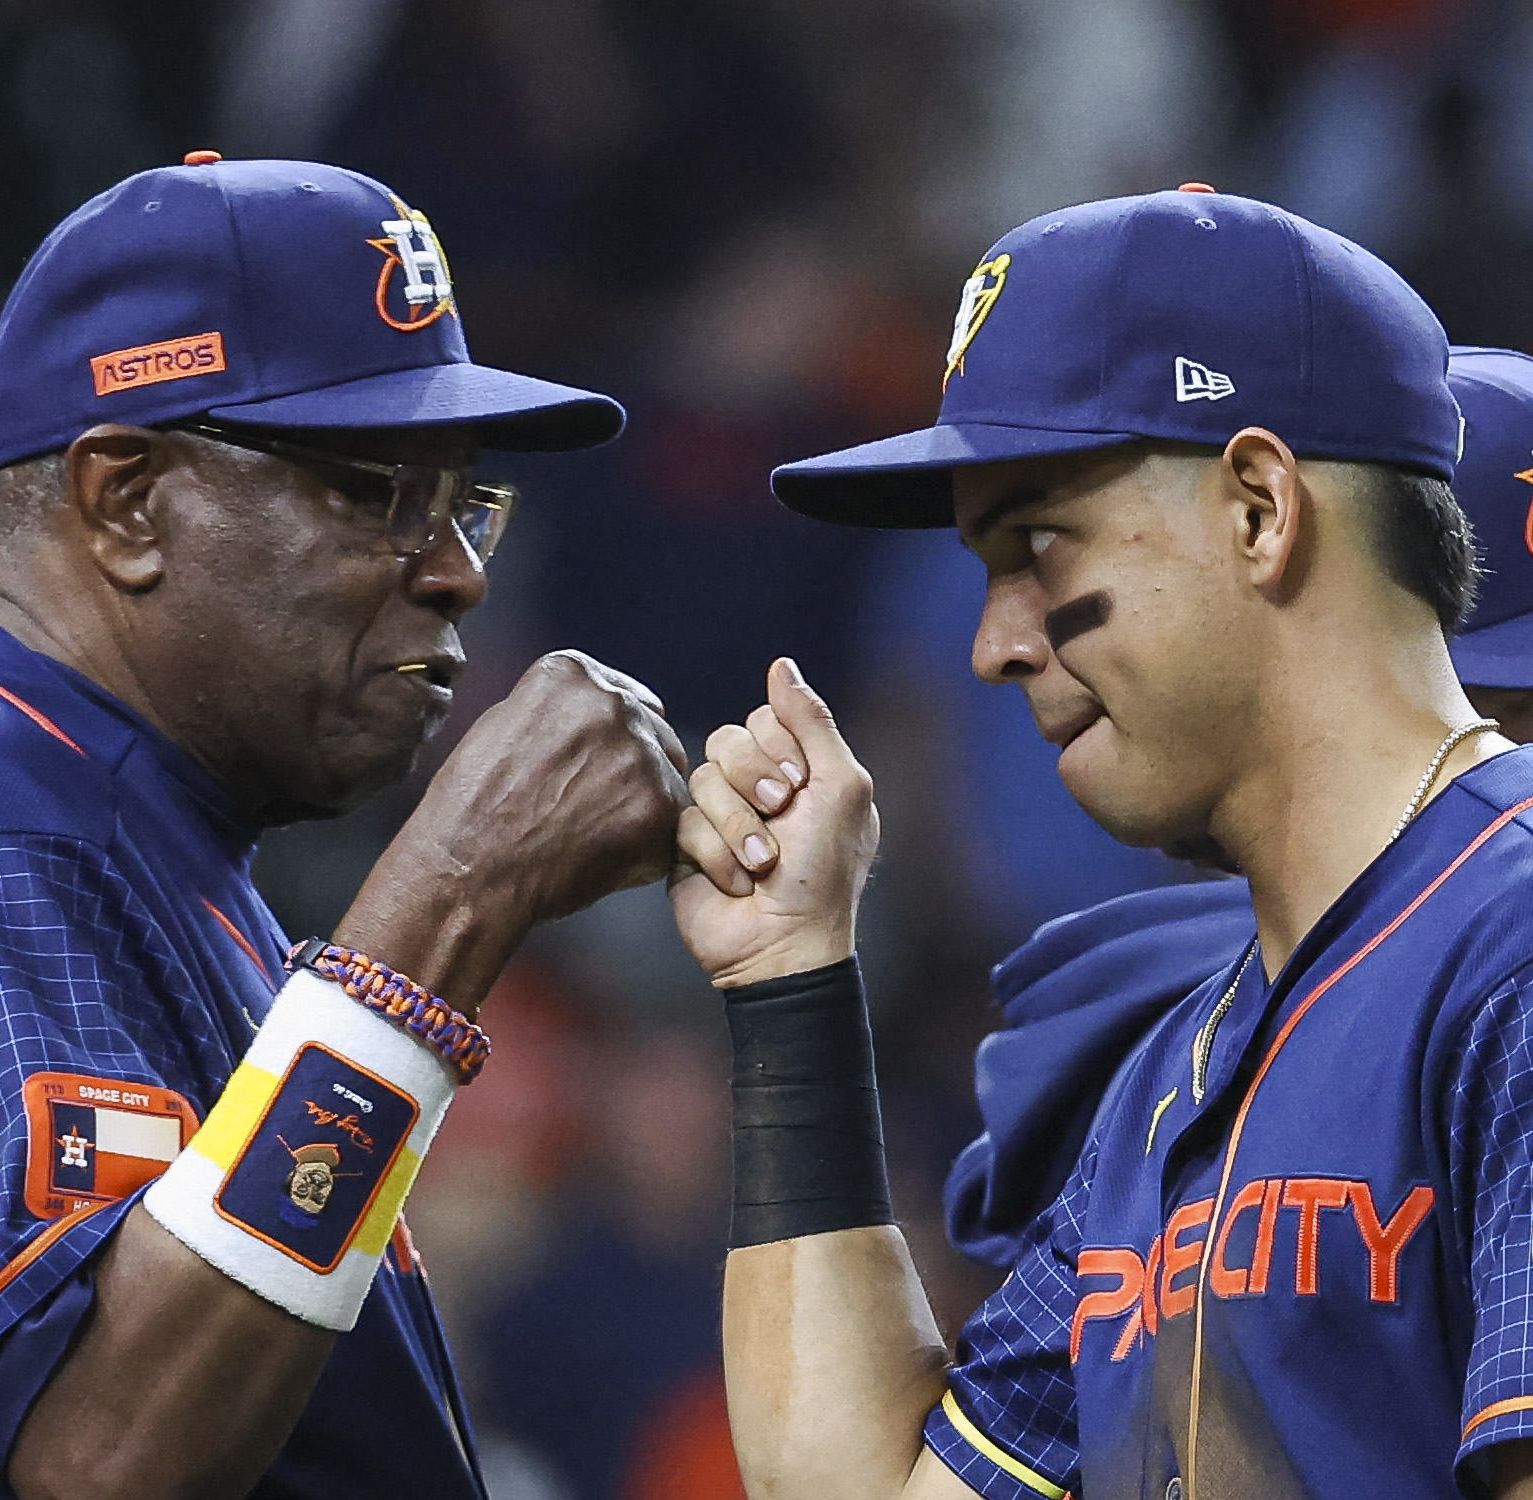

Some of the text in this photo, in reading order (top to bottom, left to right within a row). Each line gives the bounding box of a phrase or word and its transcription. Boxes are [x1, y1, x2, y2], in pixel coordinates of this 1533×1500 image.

[101, 343, 216, 388] ASTROS
[78, 1085, 120, 1103] SPACE
[122, 1090, 150, 1107] CITY
[1210, 1178, 1435, 1303] CITY
